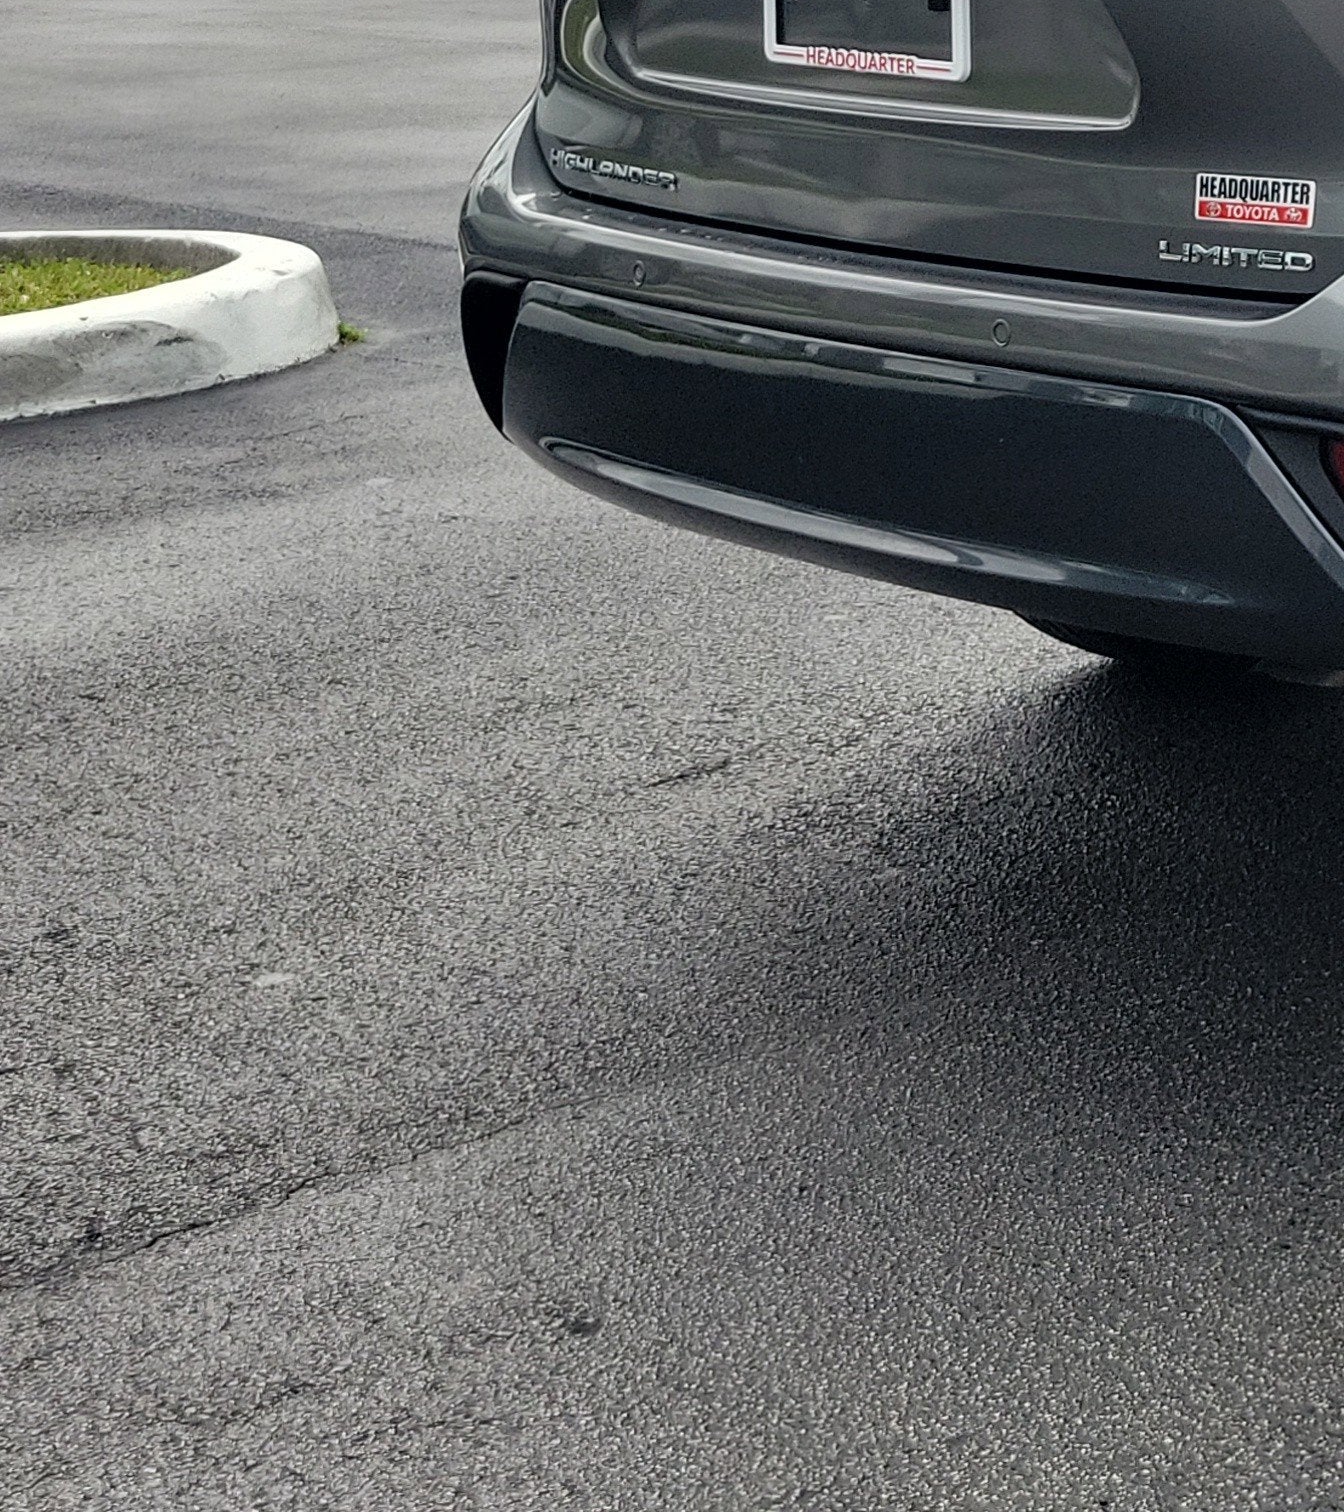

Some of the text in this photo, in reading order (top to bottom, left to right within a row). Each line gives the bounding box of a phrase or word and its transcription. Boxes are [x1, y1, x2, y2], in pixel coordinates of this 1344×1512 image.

[805, 47, 916, 74] HEADQUARTER
[550, 148, 679, 193] HIGHLANDER
[1199, 175, 1311, 205] HEADQUARTER
[1226, 204, 1280, 221] TOYOTA
[1159, 240, 1315, 272] LIMITED
